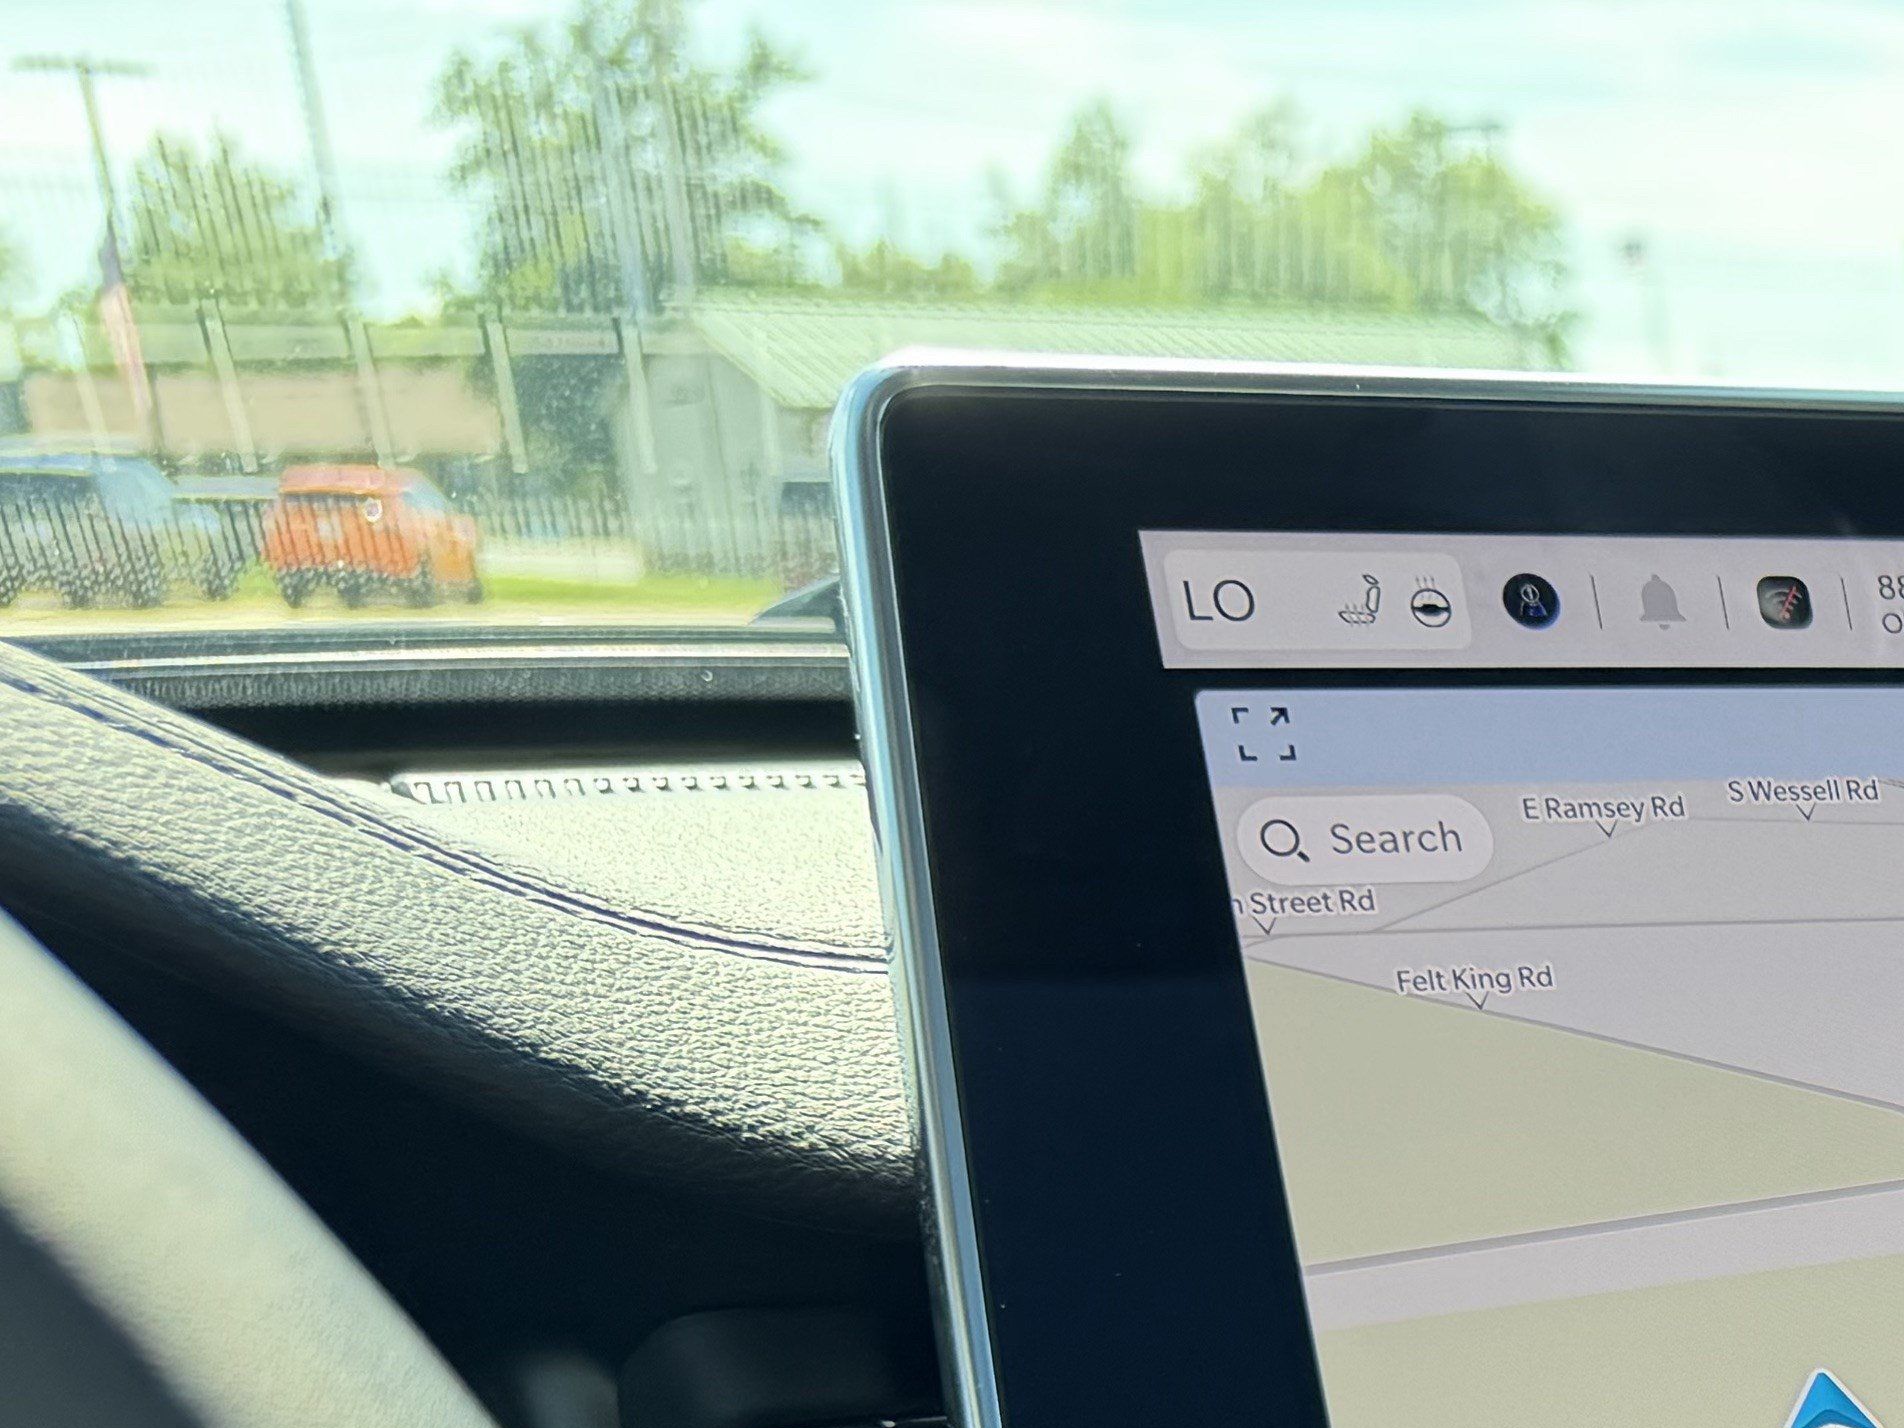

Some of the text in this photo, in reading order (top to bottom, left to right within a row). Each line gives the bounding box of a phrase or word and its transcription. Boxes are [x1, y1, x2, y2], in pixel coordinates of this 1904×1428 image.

[1184, 579, 1255, 622] LO
[1728, 779, 1879, 802] S Wessell Rd
[1523, 796, 1685, 822] E Ramsey Rd
[1331, 821, 1464, 855] Search
[1250, 892, 1333, 915] Street
[1339, 888, 1375, 912] Rd
[1397, 966, 1553, 994] Felt King Rd
